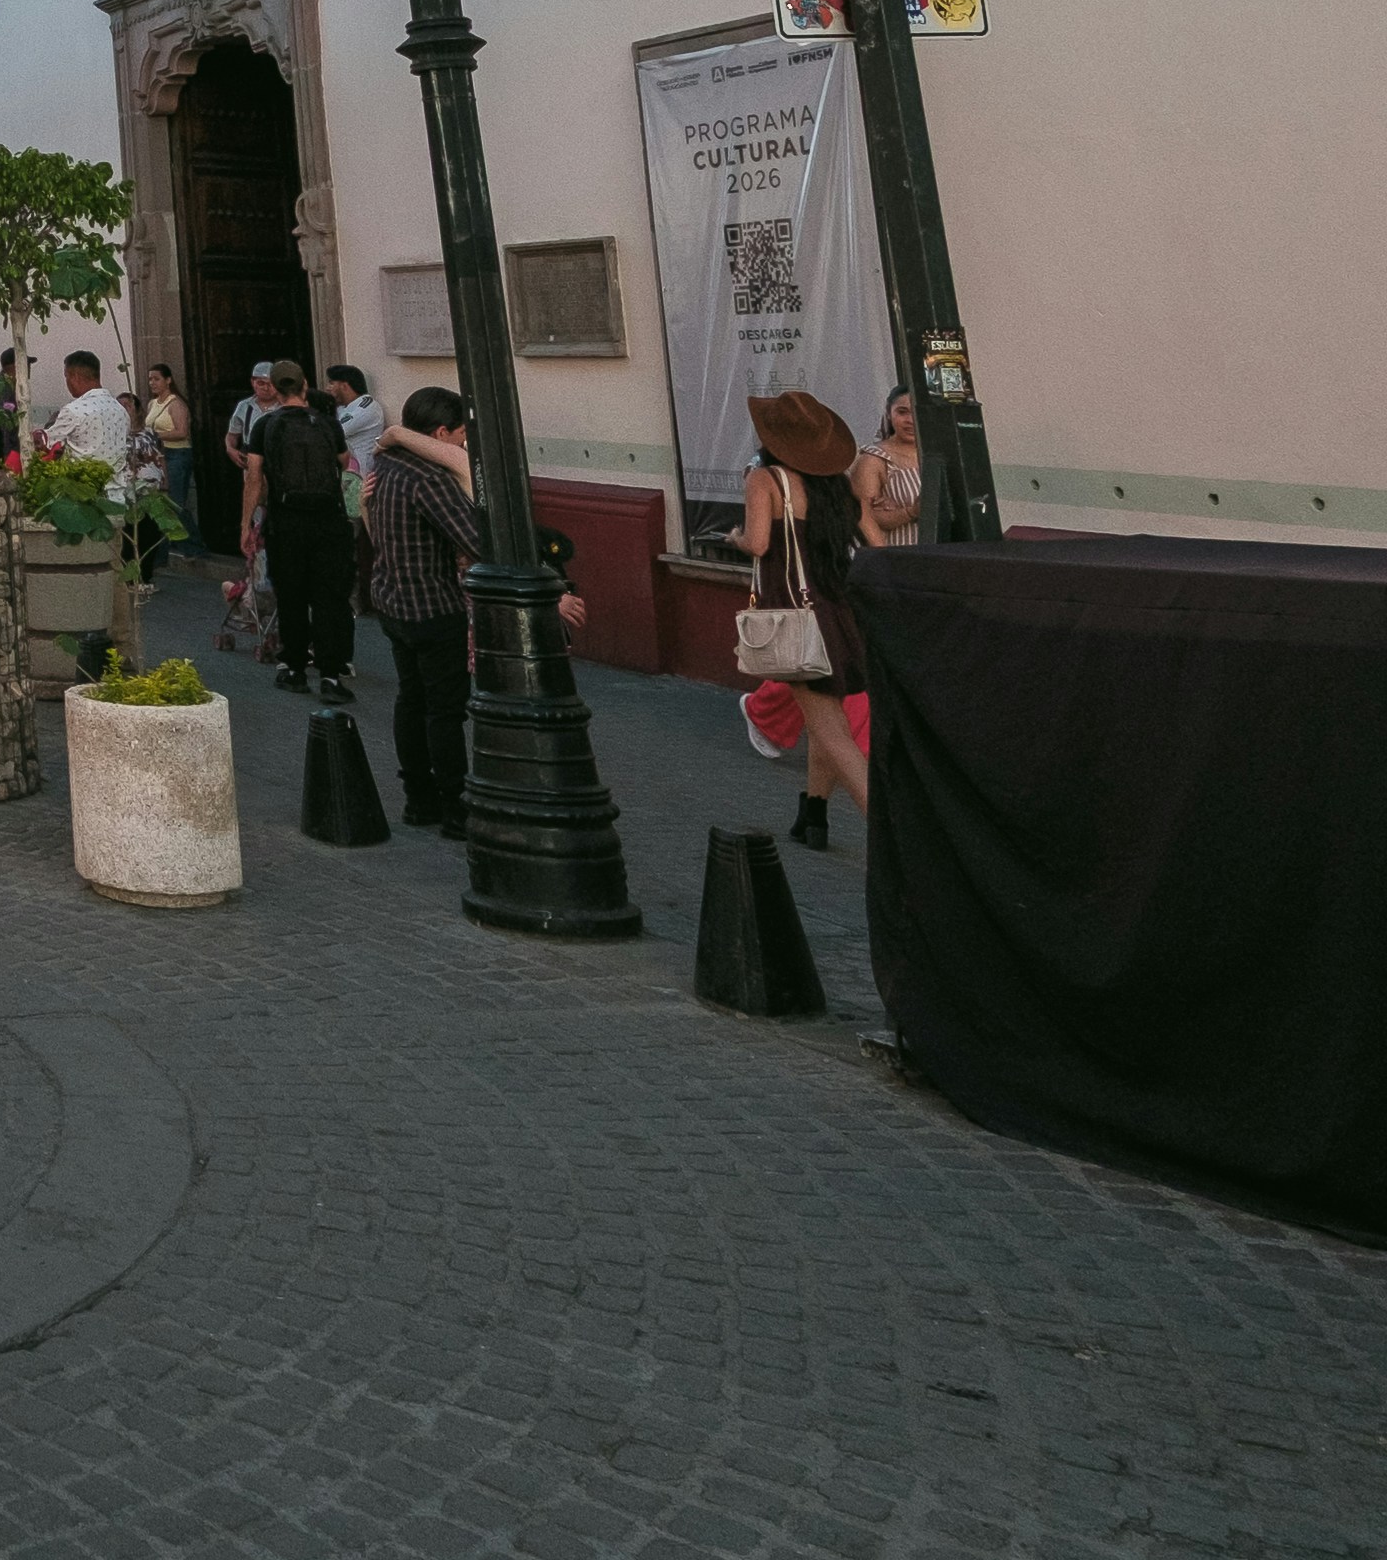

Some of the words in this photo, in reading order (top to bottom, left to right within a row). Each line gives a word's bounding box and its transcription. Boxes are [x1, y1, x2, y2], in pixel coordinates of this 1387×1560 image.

[684, 105, 815, 144] PROGRAMA
[693, 135, 810, 171] CULTURAL
[727, 168, 781, 193] 2026
[738, 328, 802, 340] DESCARGA
[753, 343, 767, 354] LA
[771, 342, 795, 353] APP
